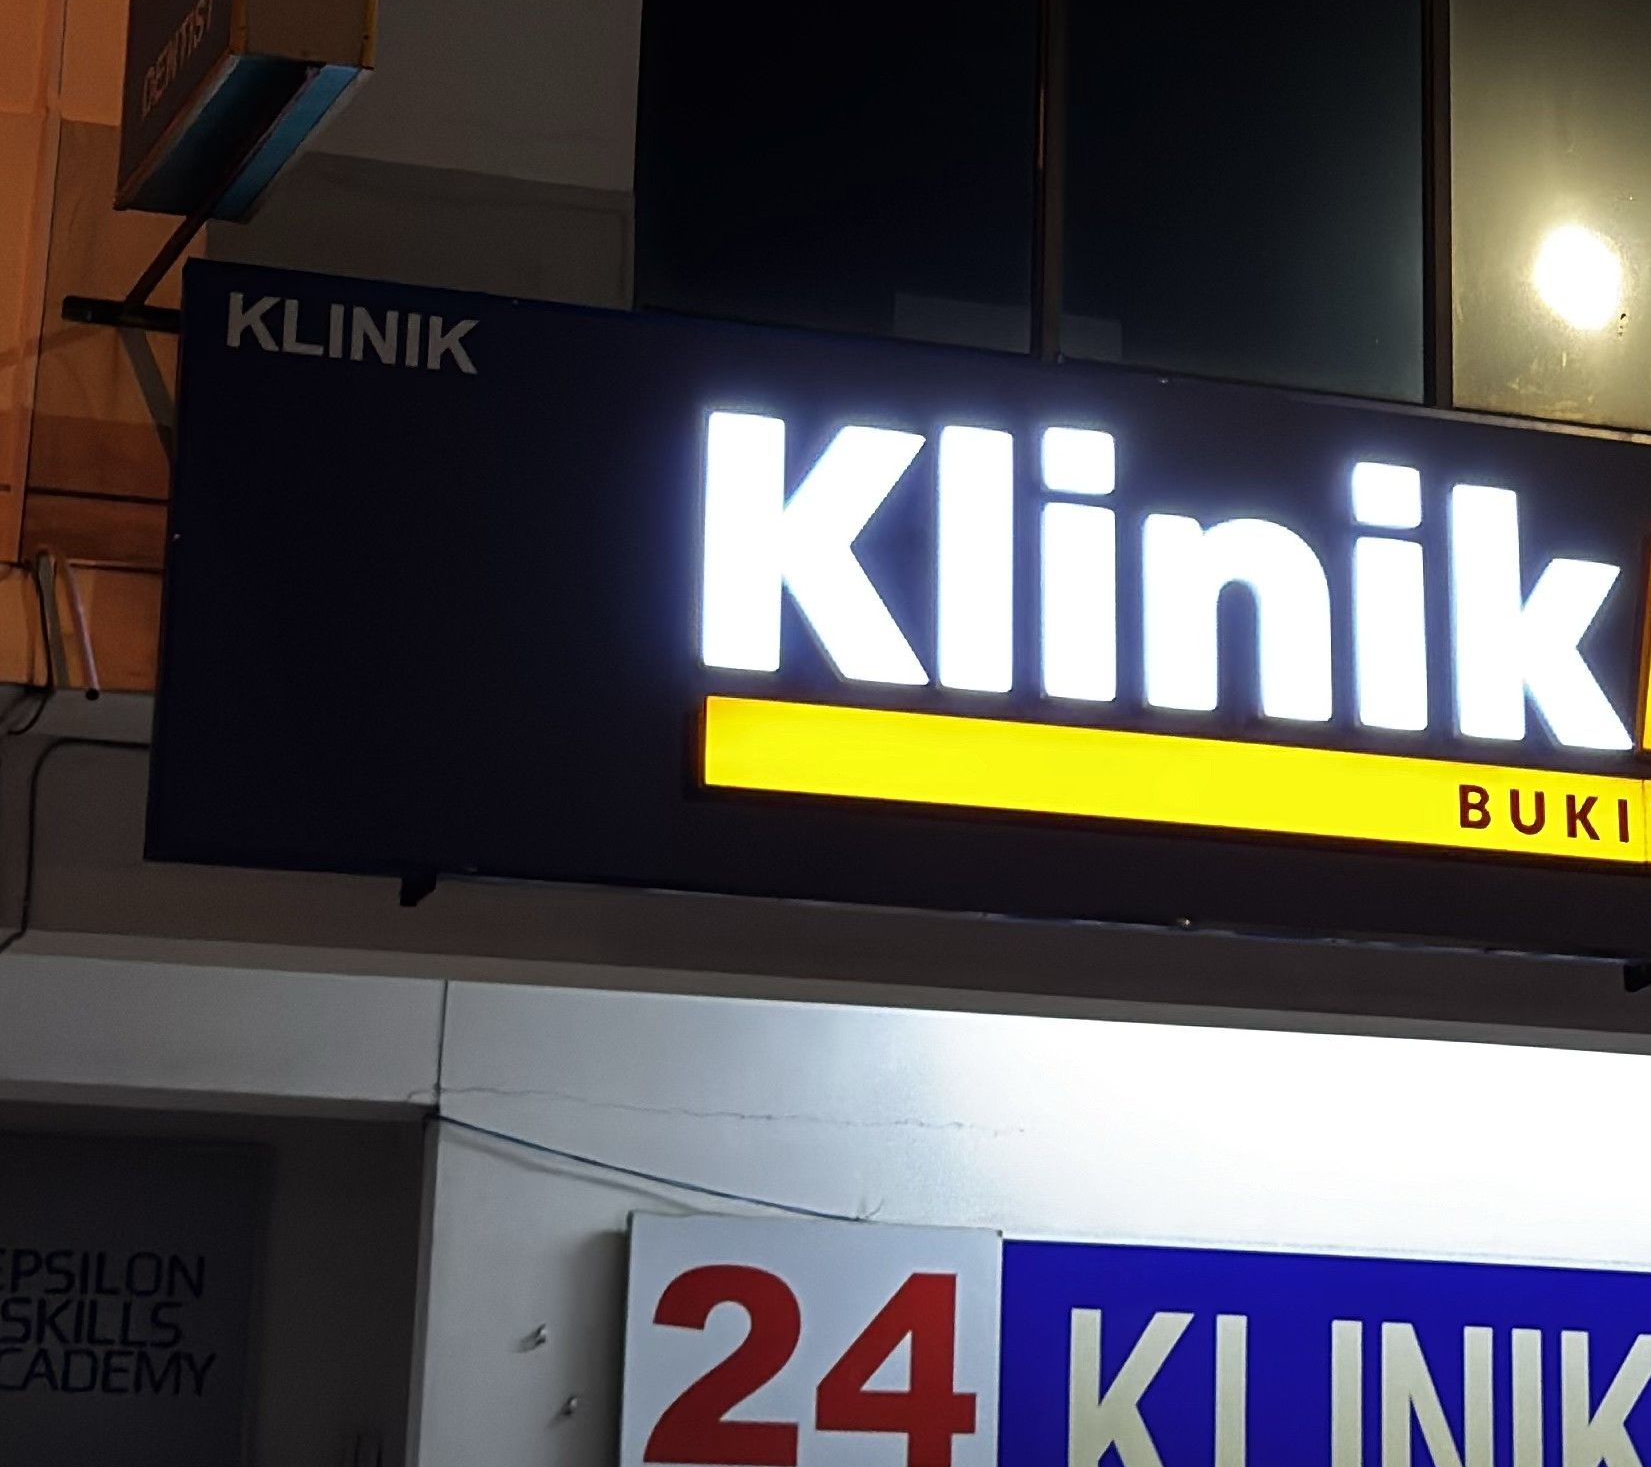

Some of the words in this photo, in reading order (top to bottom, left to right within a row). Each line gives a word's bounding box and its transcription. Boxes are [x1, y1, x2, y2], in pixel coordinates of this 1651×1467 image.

[225, 291, 480, 376] KLINIK
[0, 1248, 207, 1299] PSILON
[0, 1296, 185, 1349] SKILLS
